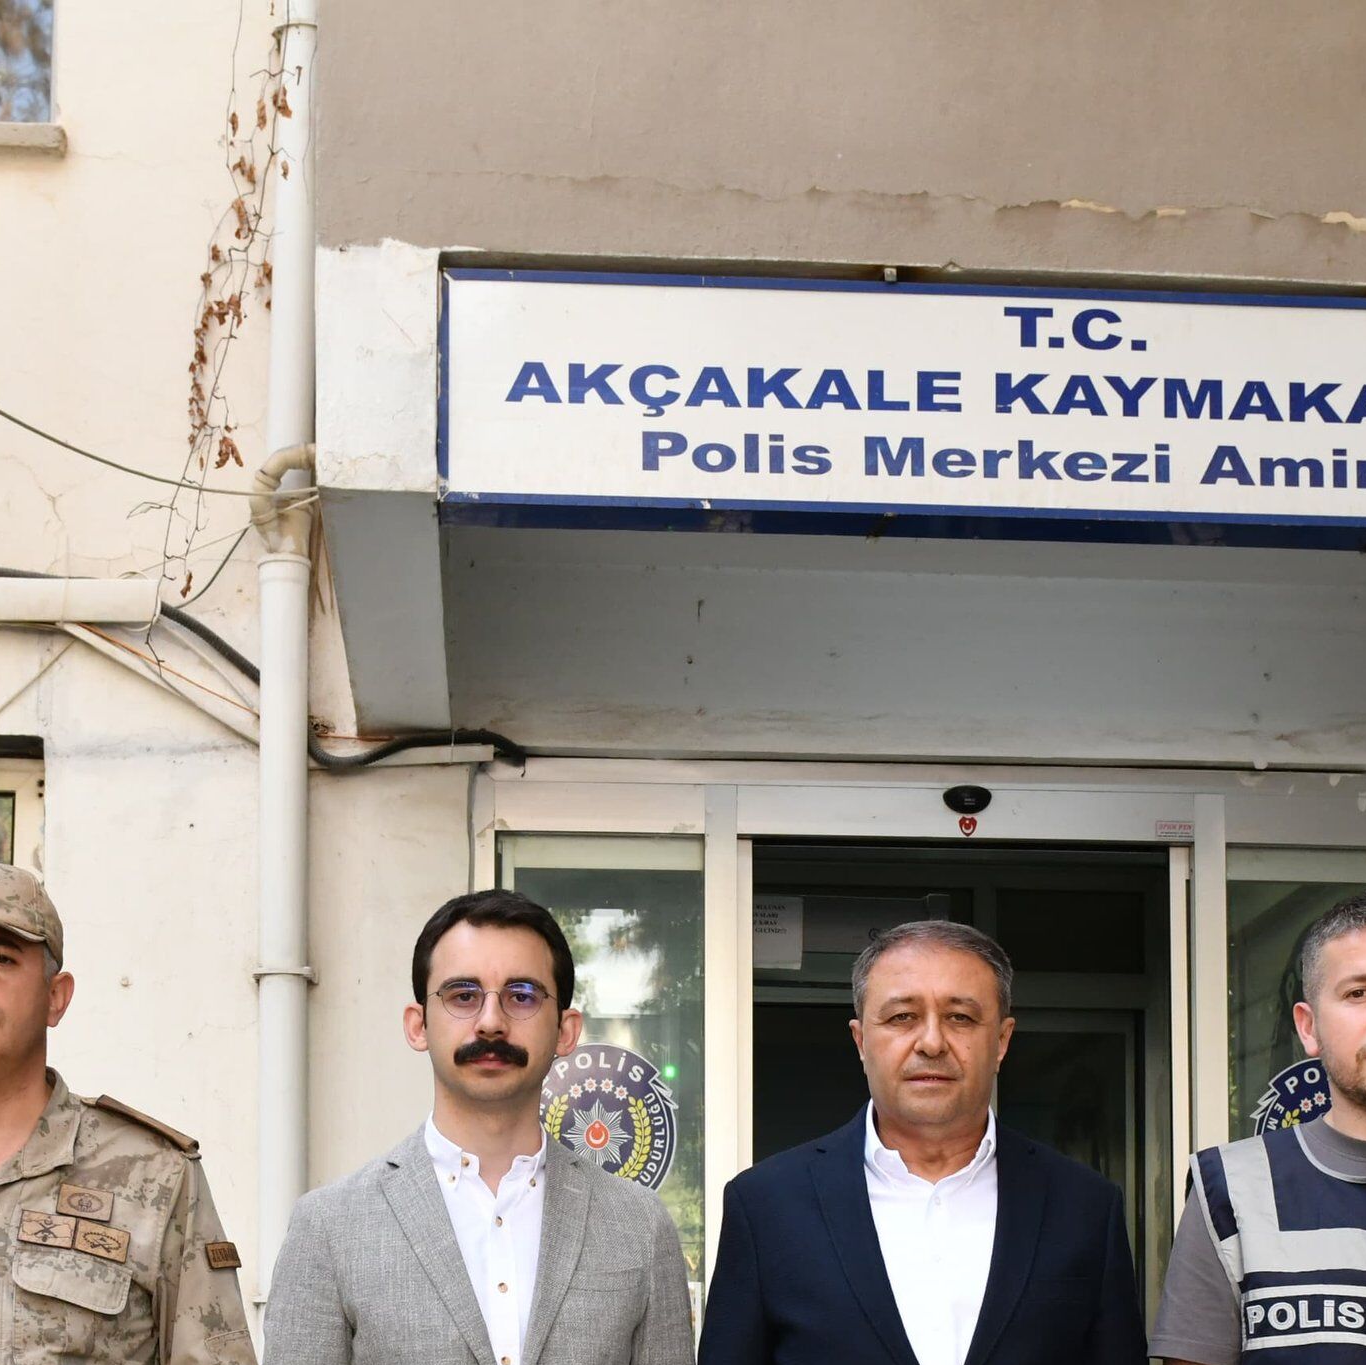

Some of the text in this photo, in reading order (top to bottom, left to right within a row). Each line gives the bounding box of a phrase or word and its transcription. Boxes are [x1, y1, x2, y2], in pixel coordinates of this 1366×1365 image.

[1004, 306, 1147, 351] T.C.
[506, 362, 962, 417] AKÇAKALE
[642, 431, 833, 475] Polis
[864, 436, 1170, 483] Merkezi
[554, 1051, 645, 1083] POLİS
[639, 1092, 665, 1183] ÜDÜRLÜĞÜ
[1246, 1299, 1366, 1334] POLİS
